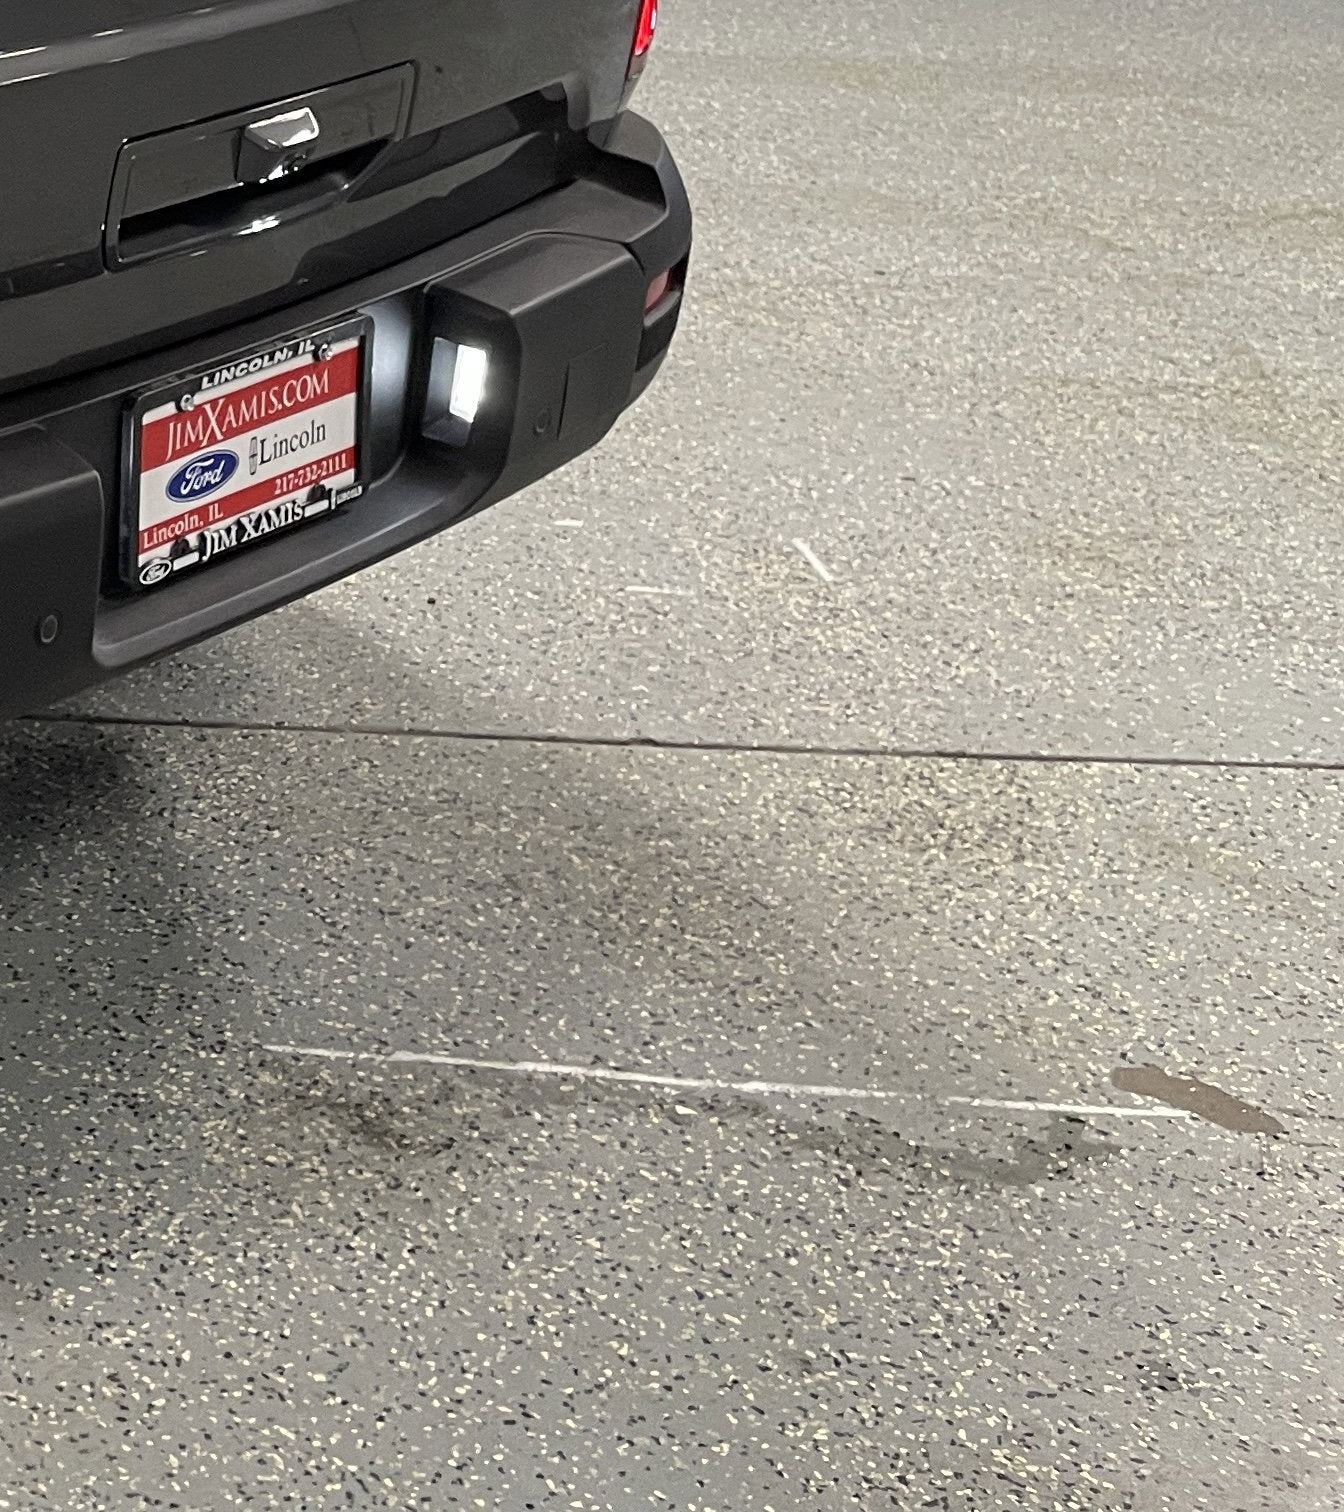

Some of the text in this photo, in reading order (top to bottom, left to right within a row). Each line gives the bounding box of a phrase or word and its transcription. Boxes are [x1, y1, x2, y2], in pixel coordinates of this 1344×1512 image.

[201, 339, 315, 389] LINCOLN, IL
[258, 419, 327, 466] Lincoln
[180, 457, 224, 496] Ford
[274, 453, 348, 495] 217-732-2111
[202, 503, 305, 561] JIM XAMIS
[208, 504, 224, 523] IL
